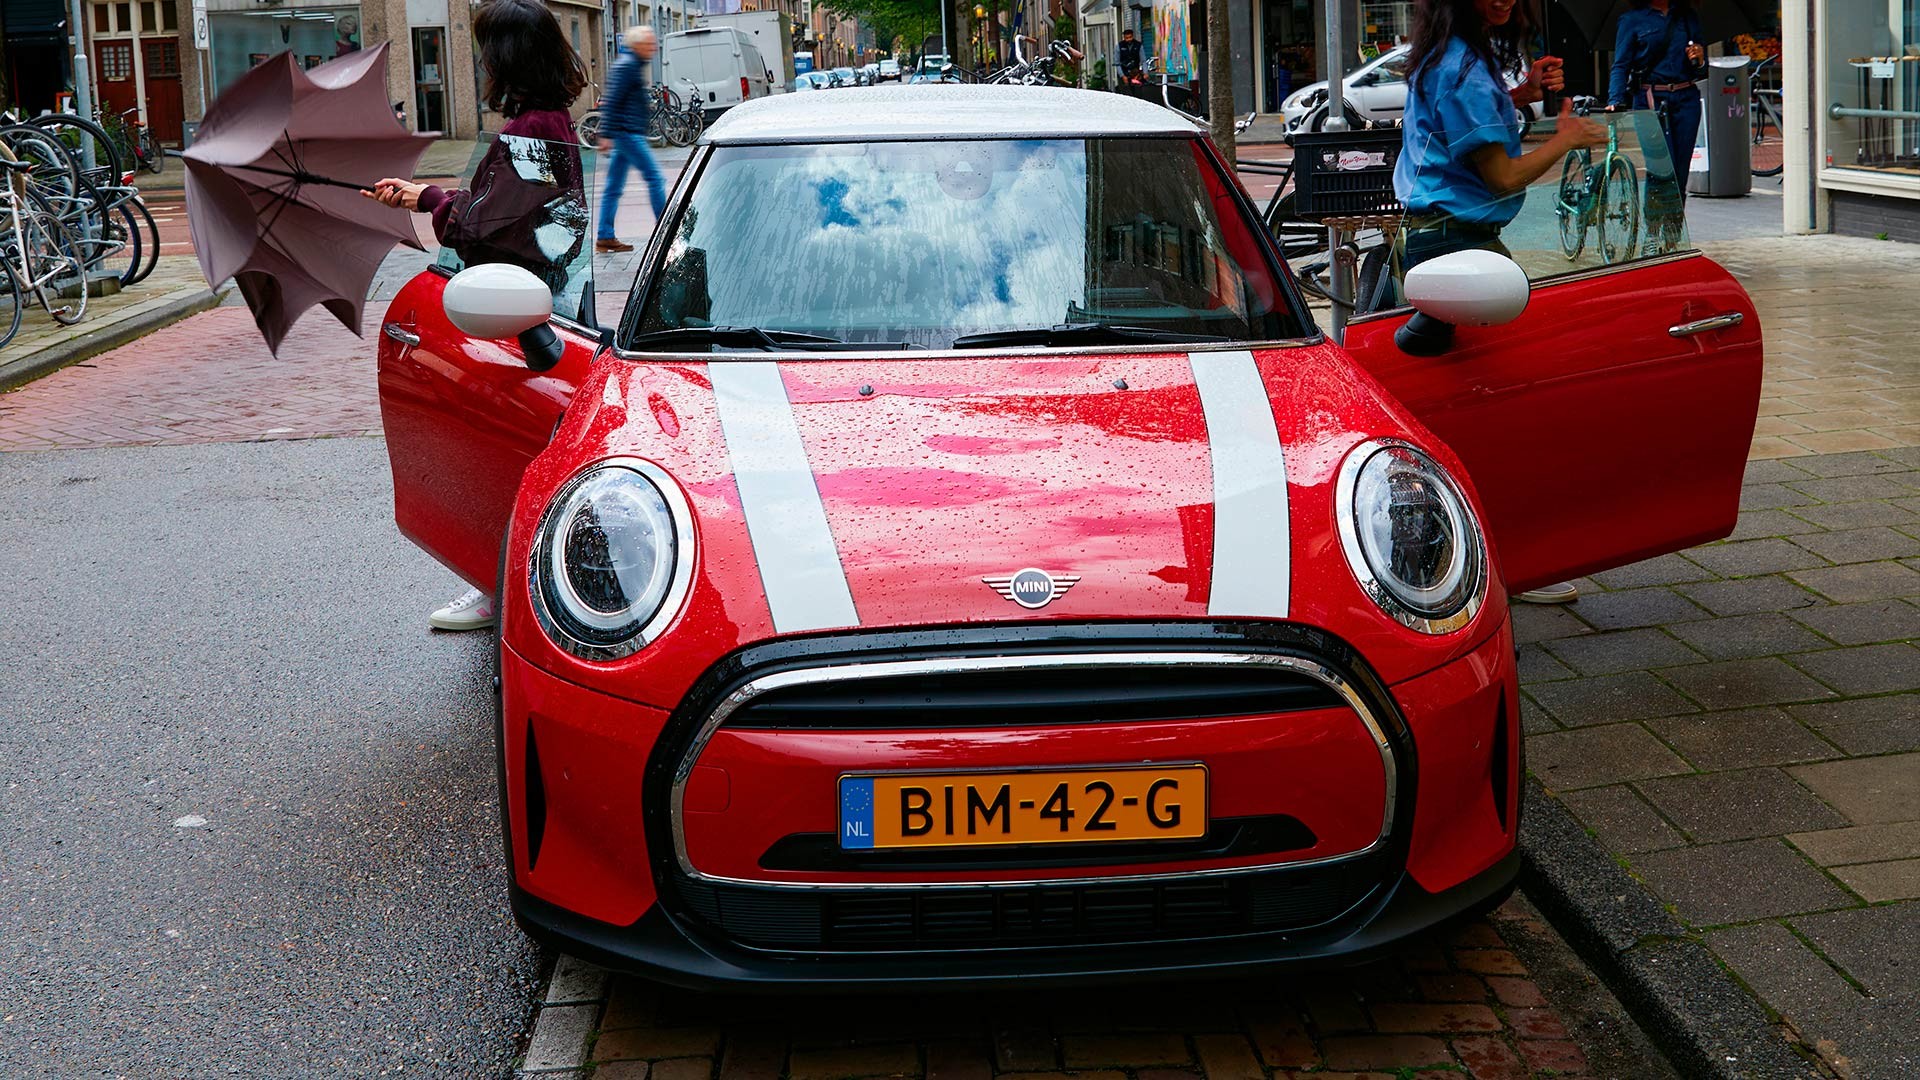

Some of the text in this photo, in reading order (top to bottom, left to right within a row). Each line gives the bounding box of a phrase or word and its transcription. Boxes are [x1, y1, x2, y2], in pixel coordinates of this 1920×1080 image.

[1015, 582, 1049, 593] MINI
[899, 778, 1181, 837] BIM-42-G
[846, 821, 869, 837] NL
